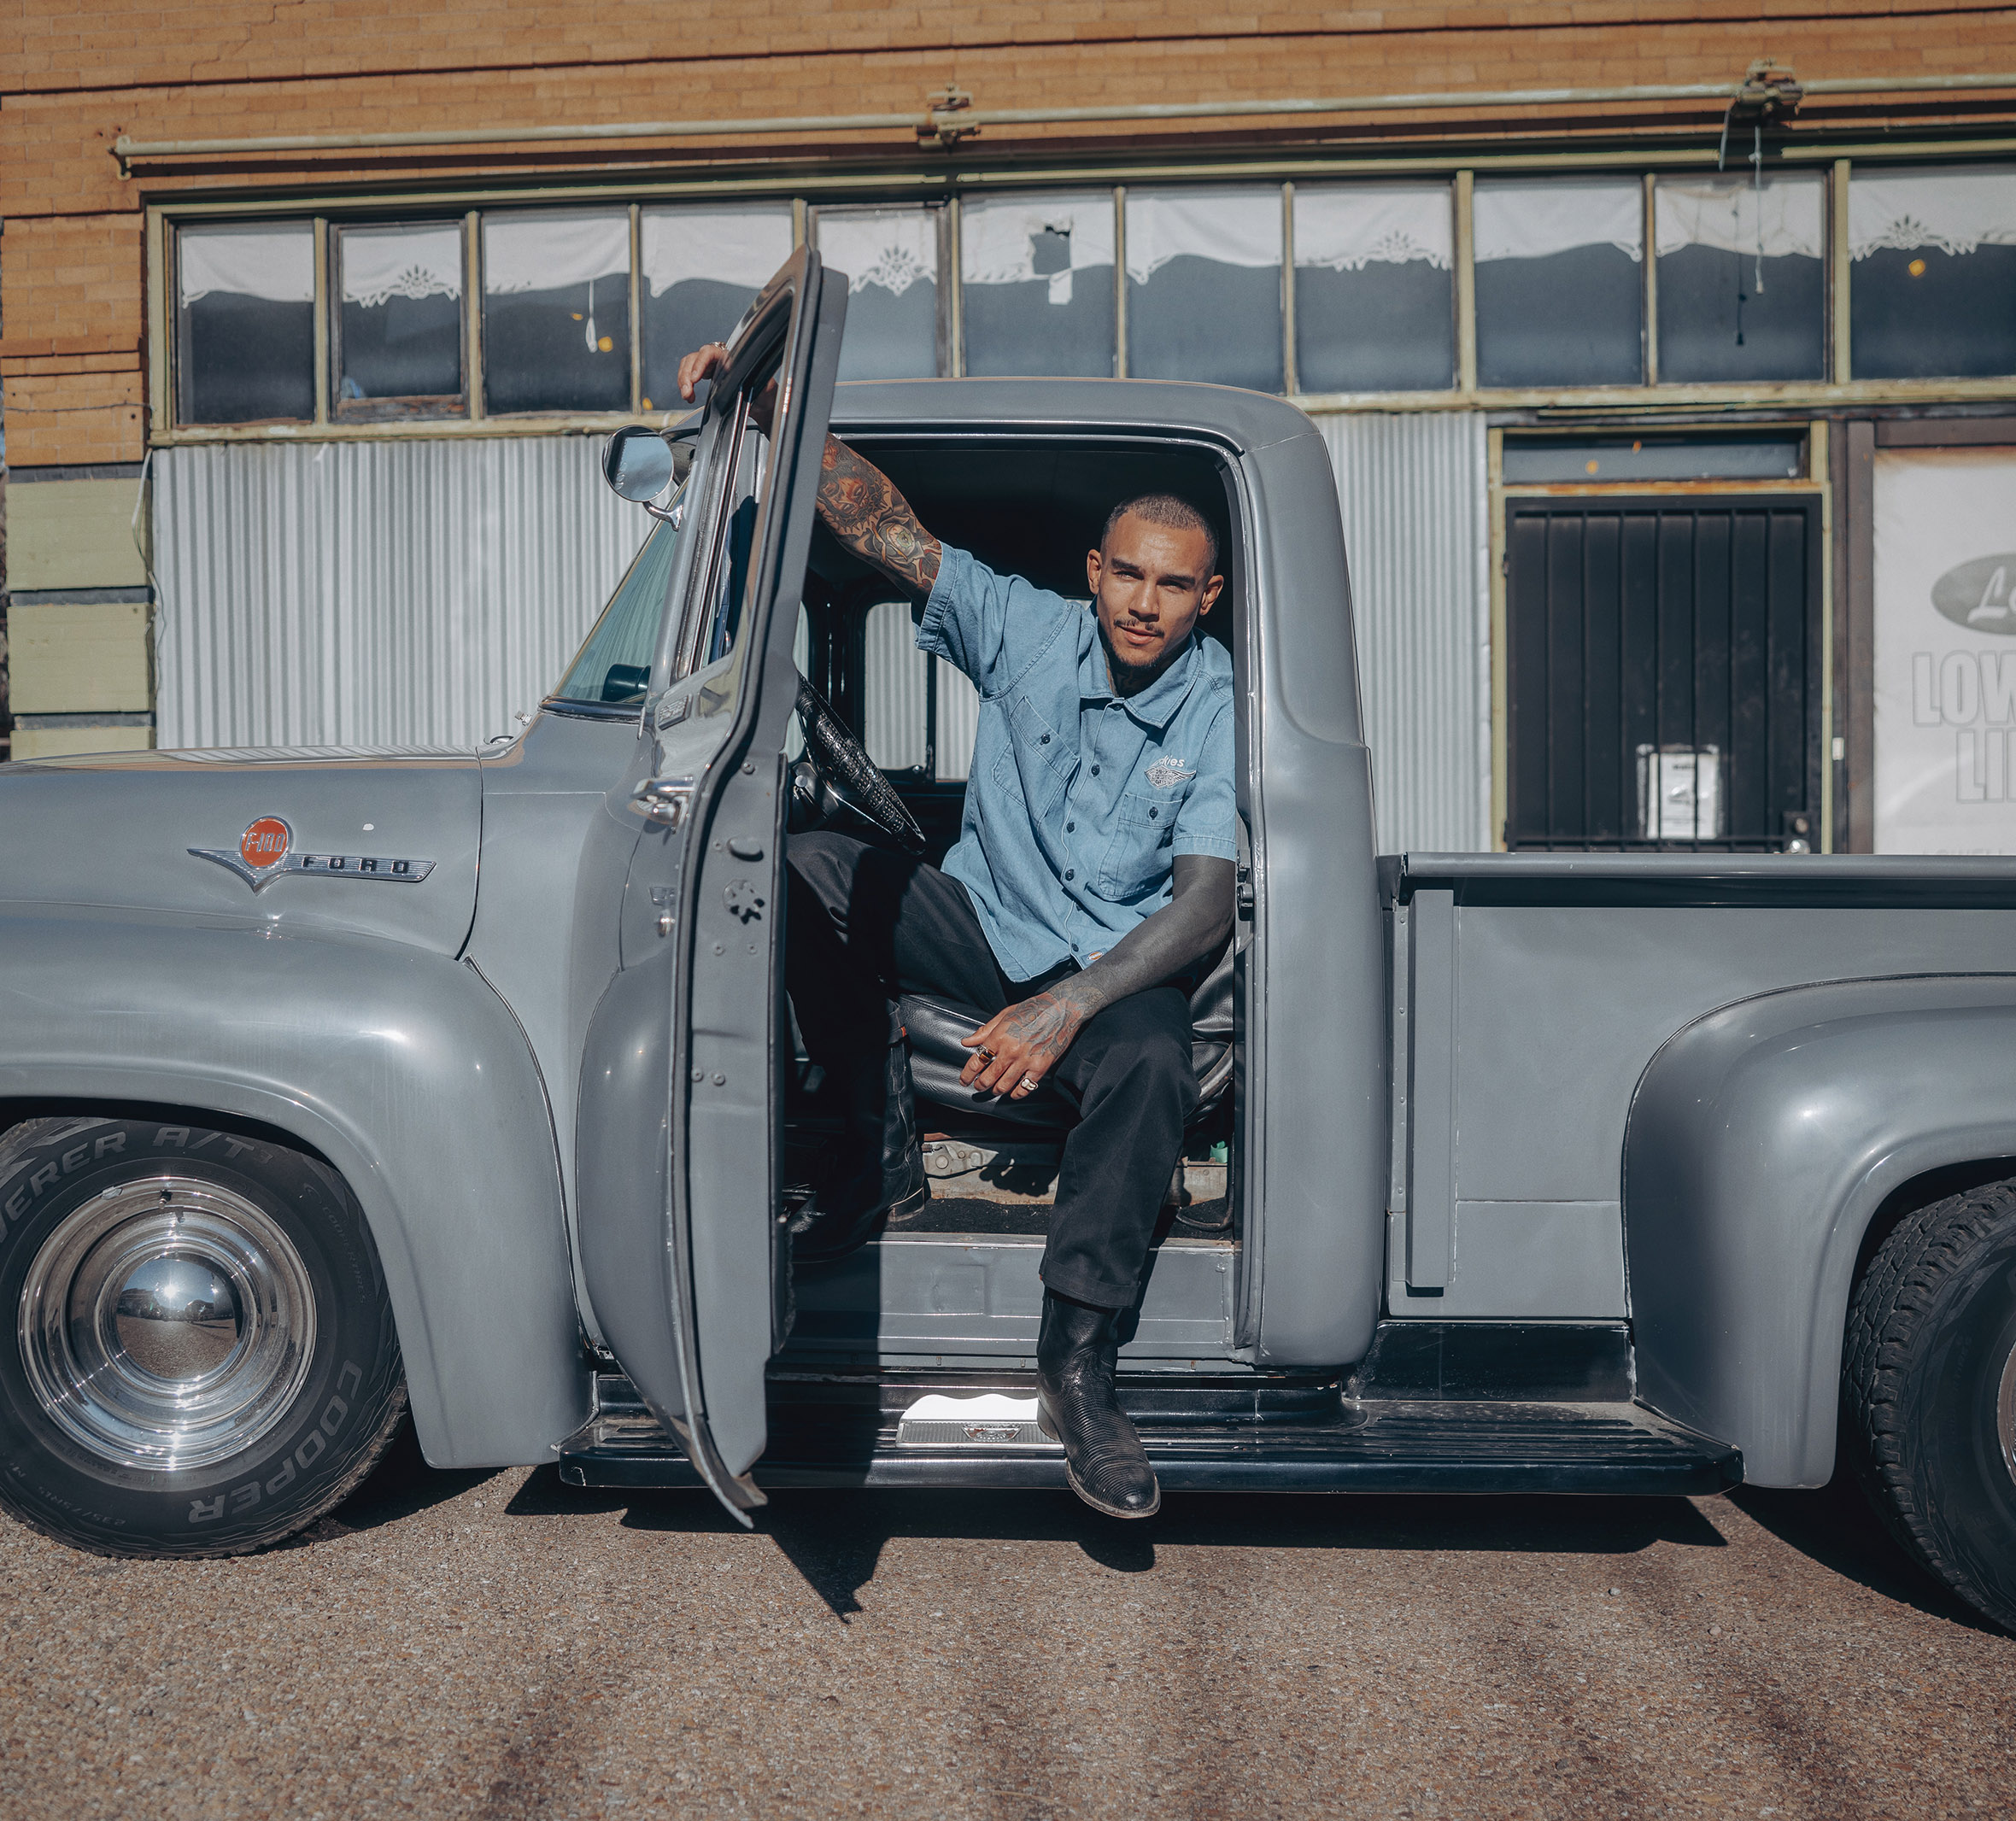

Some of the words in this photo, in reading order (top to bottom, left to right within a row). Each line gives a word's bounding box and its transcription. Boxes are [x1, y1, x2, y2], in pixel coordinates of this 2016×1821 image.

[244, 831, 286, 853] F-100
[302, 855, 411, 875] FORD
[187, 1359, 363, 1524] COOPER
